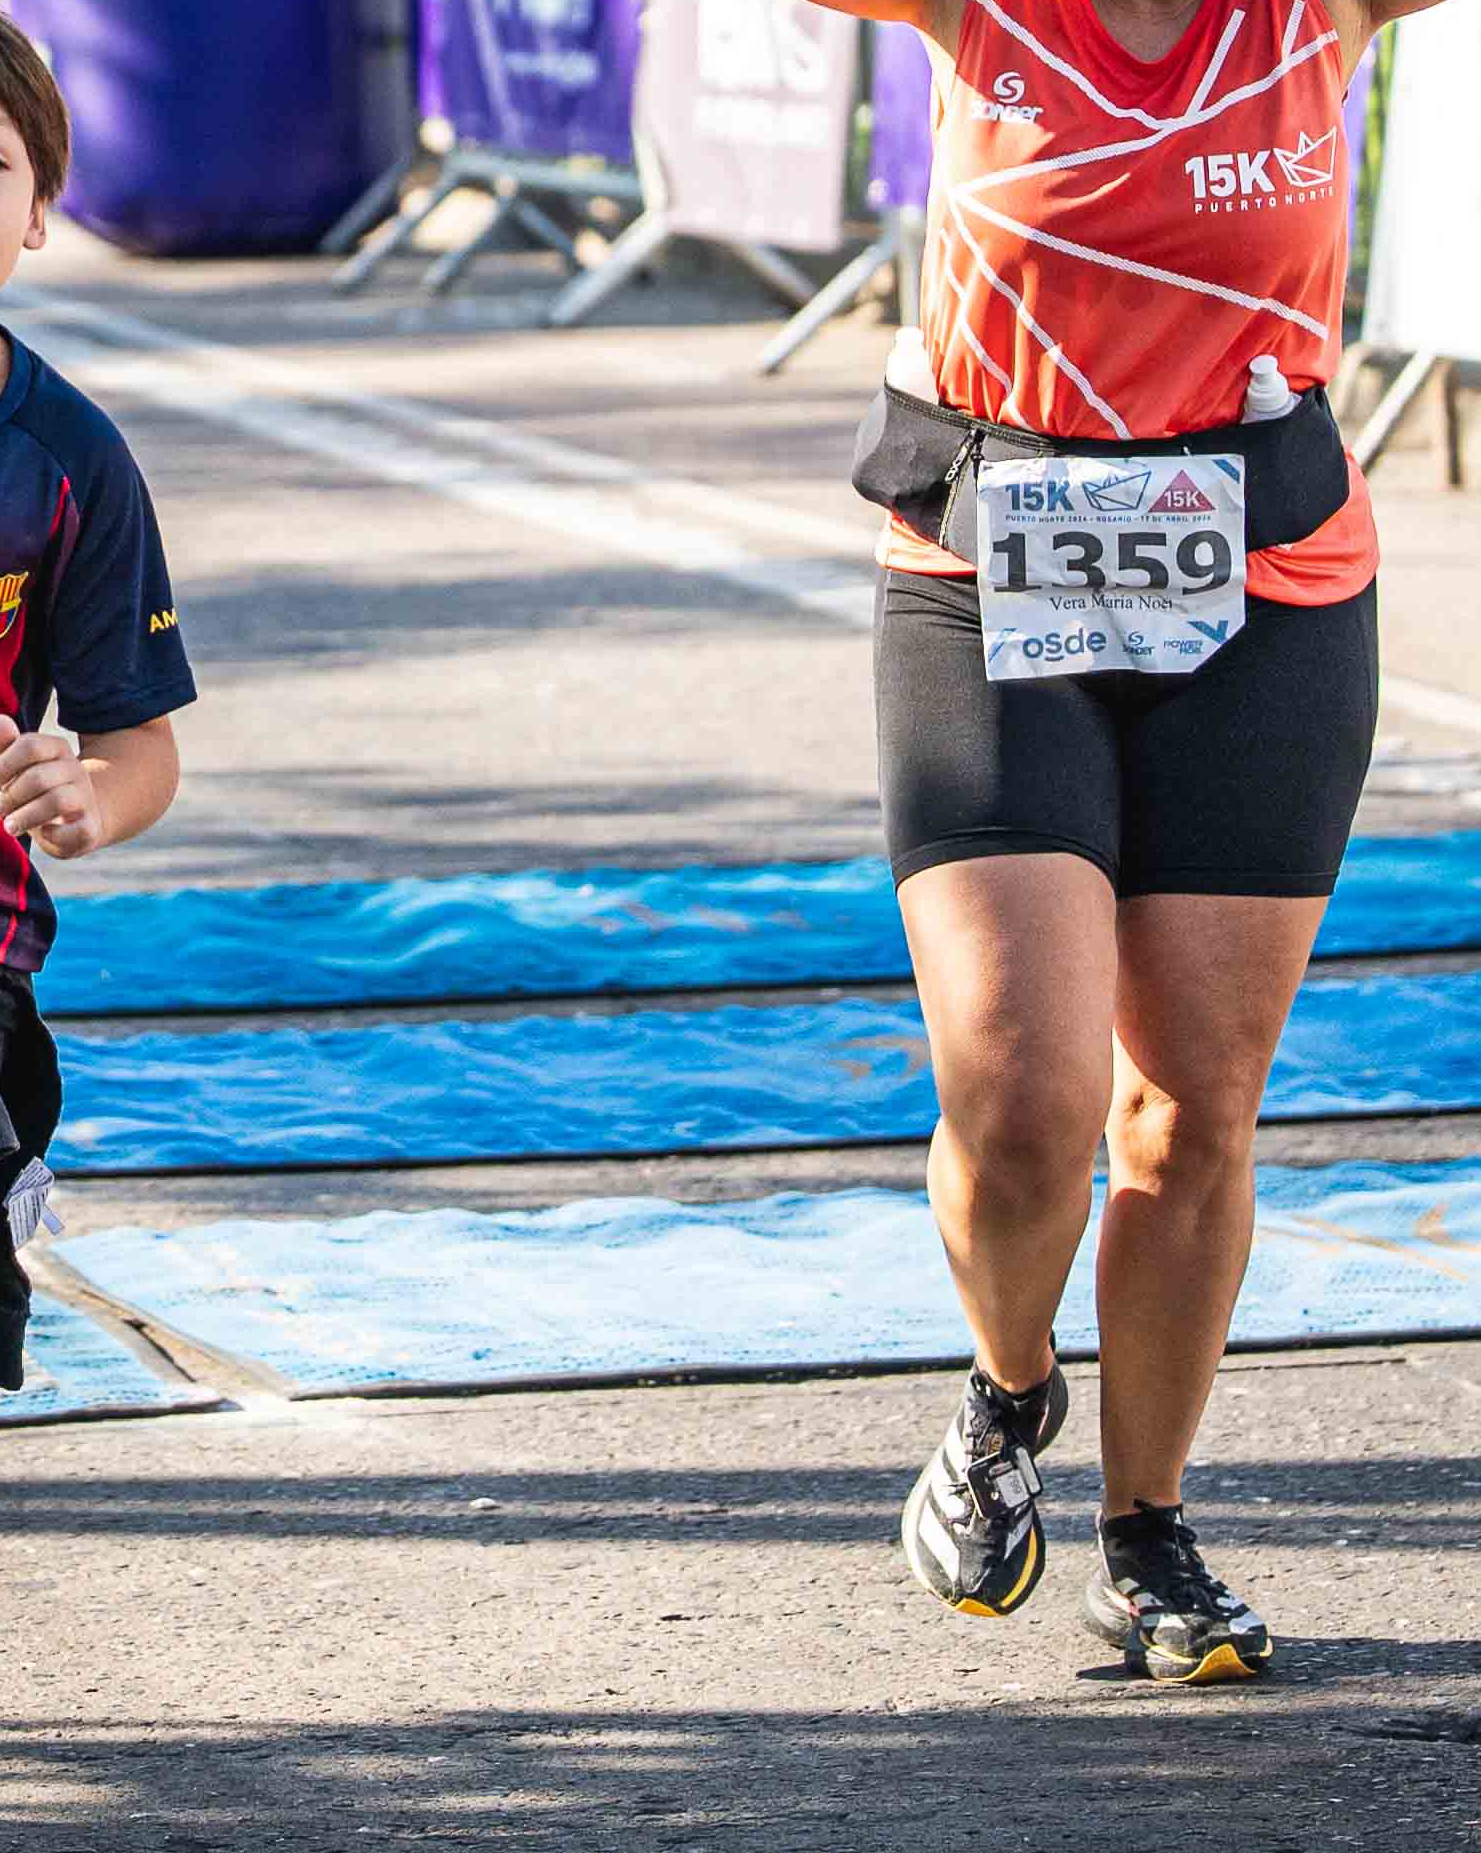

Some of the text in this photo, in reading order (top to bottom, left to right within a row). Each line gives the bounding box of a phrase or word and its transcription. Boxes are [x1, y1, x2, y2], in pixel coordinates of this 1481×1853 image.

[1184, 151, 1276, 200] 15K
[1005, 480, 1201, 512] 15K 15K
[992, 529, 1233, 596] 1359
[1049, 595, 1087, 612] Vera
[1091, 593, 1134, 612] Maria
[1022, 626, 1109, 662] osde
